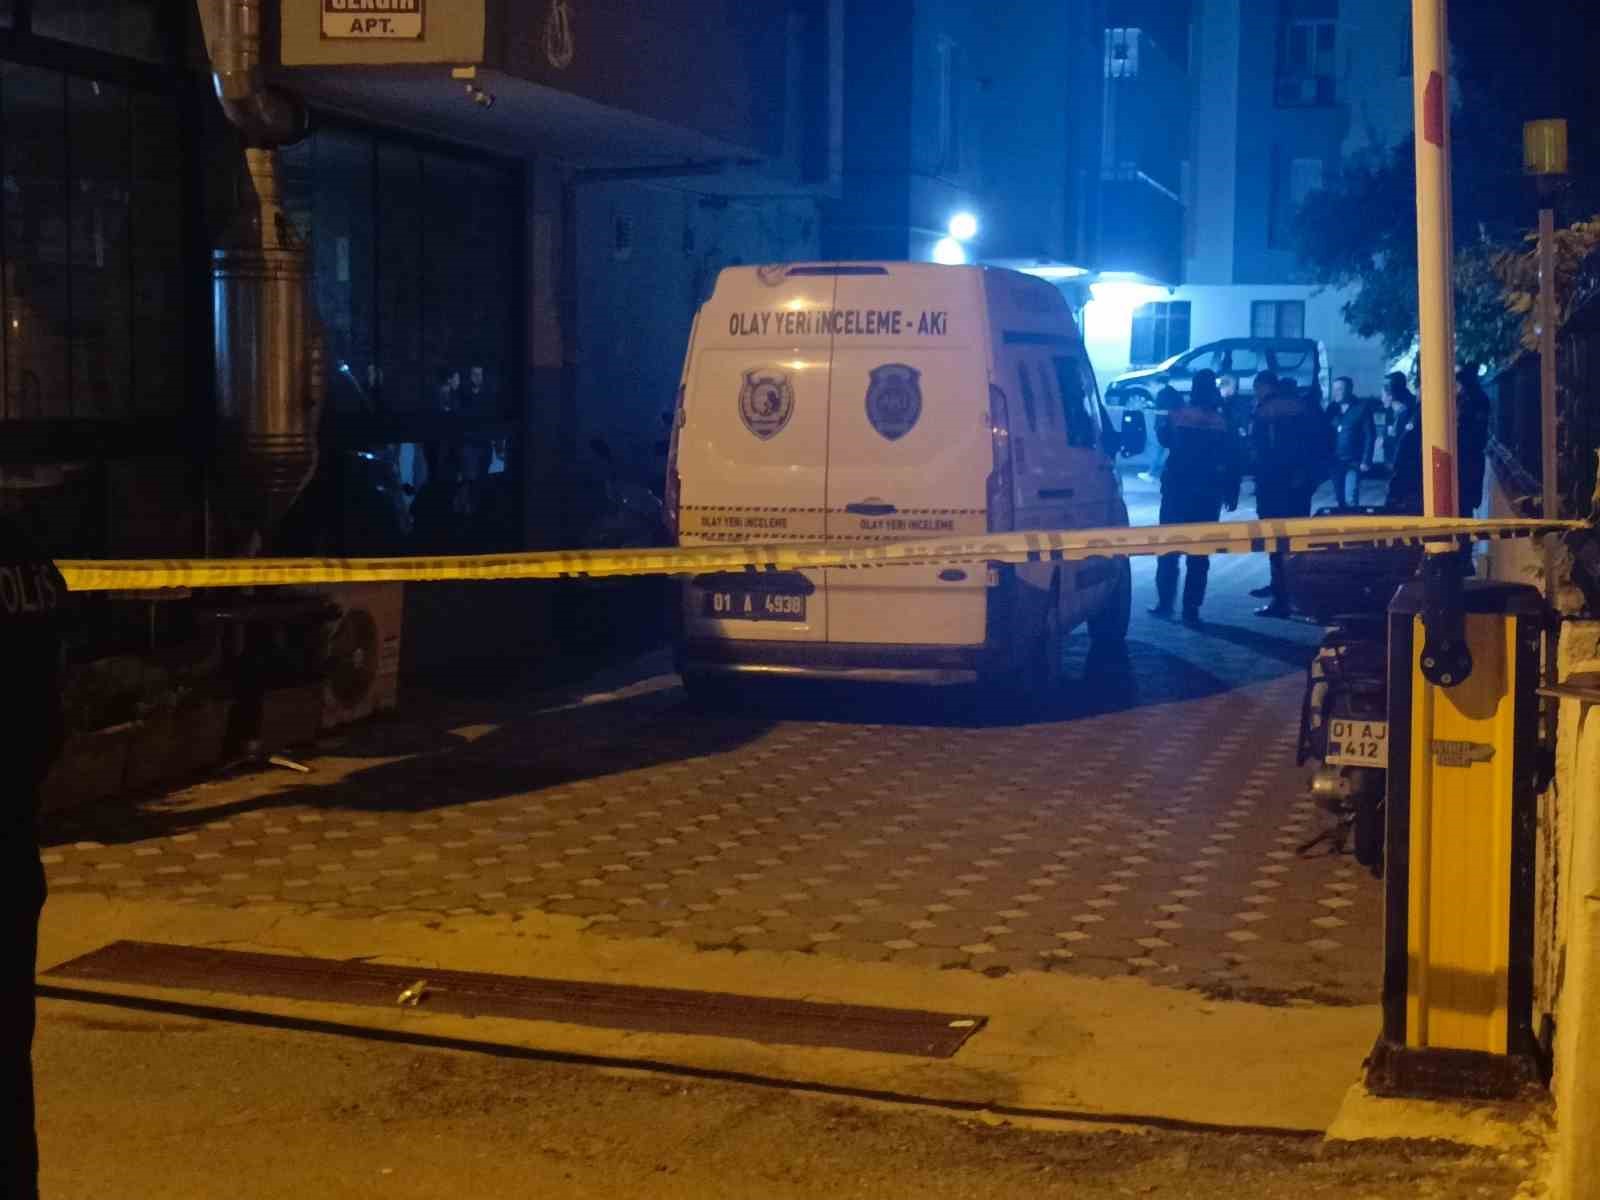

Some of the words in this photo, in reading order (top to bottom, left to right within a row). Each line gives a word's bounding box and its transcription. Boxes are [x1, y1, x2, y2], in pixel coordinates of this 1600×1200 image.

[350, 17, 395, 33] APT.
[729, 311, 771, 336] OLAY
[713, 592, 731, 612] 01
[743, 593, 753, 613] A
[1333, 722, 1353, 738] 01
[1345, 741, 1378, 758] 412
